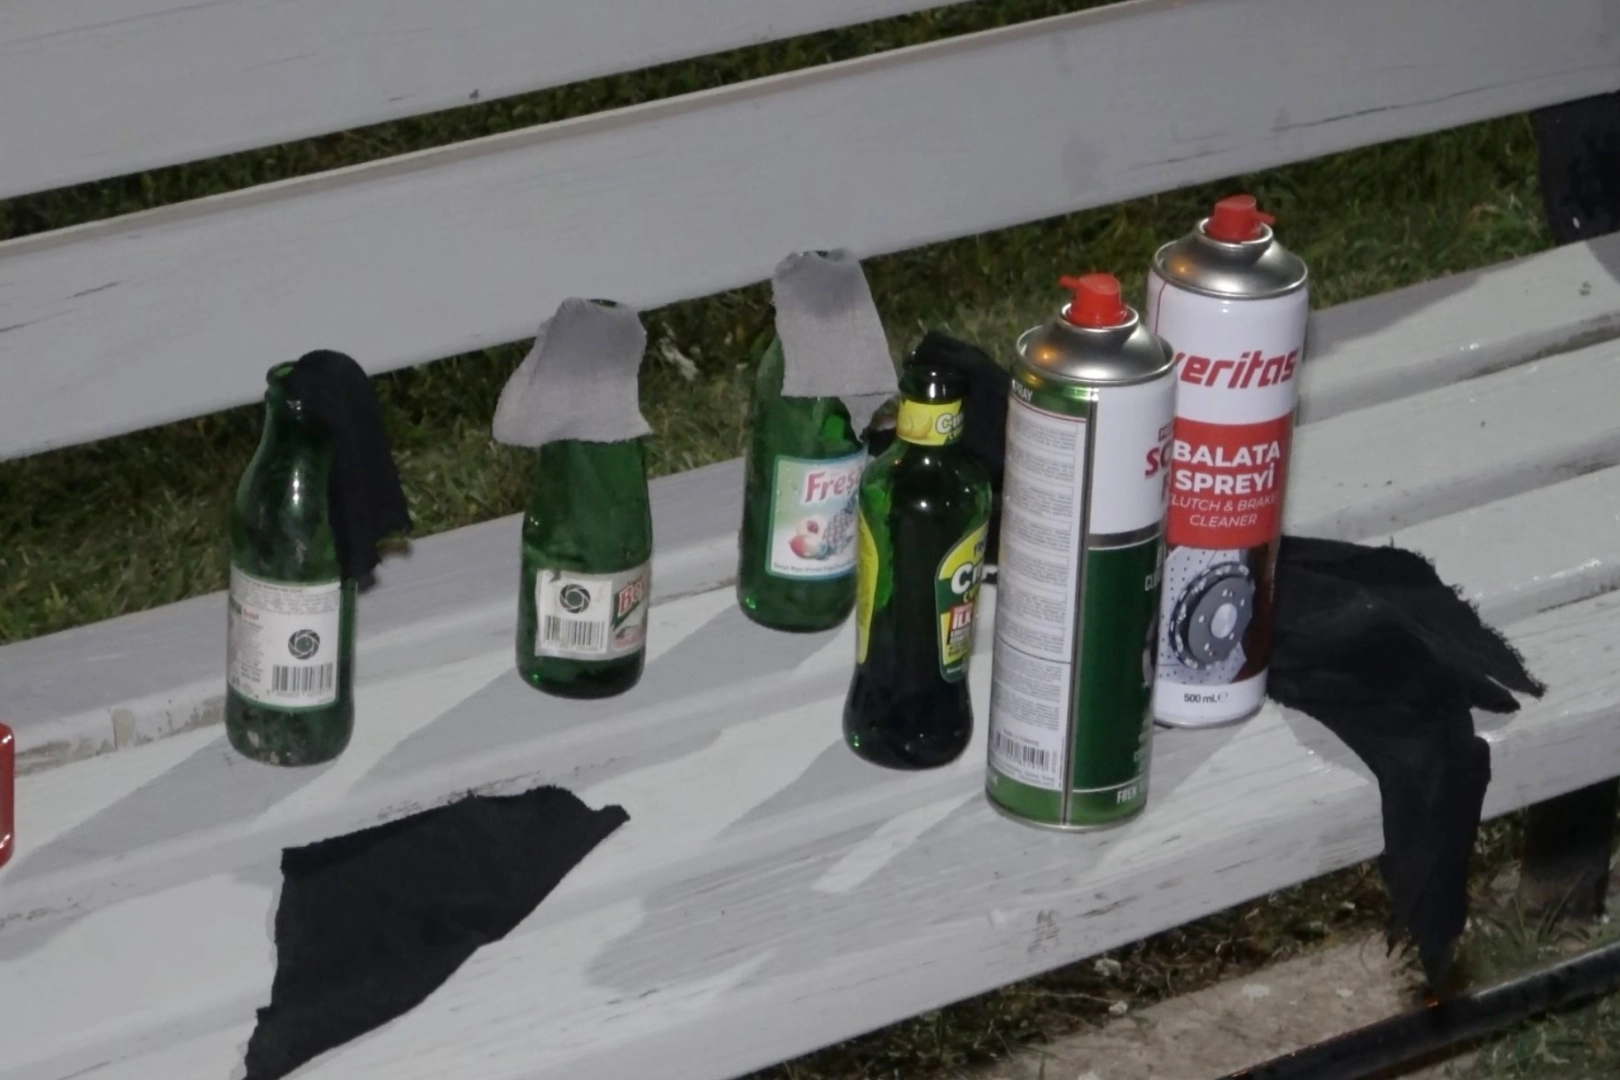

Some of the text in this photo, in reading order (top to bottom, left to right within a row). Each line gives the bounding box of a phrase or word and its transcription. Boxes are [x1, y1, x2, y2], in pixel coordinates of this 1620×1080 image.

[1172, 440, 1281, 467] BALATA
[1174, 463, 1274, 494] SPREYİ
[1170, 493, 1221, 511] LUTCH
[1223, 500, 1233, 512] &
[1189, 514, 1258, 528] CLEANER
[1184, 693, 1201, 703] 500
